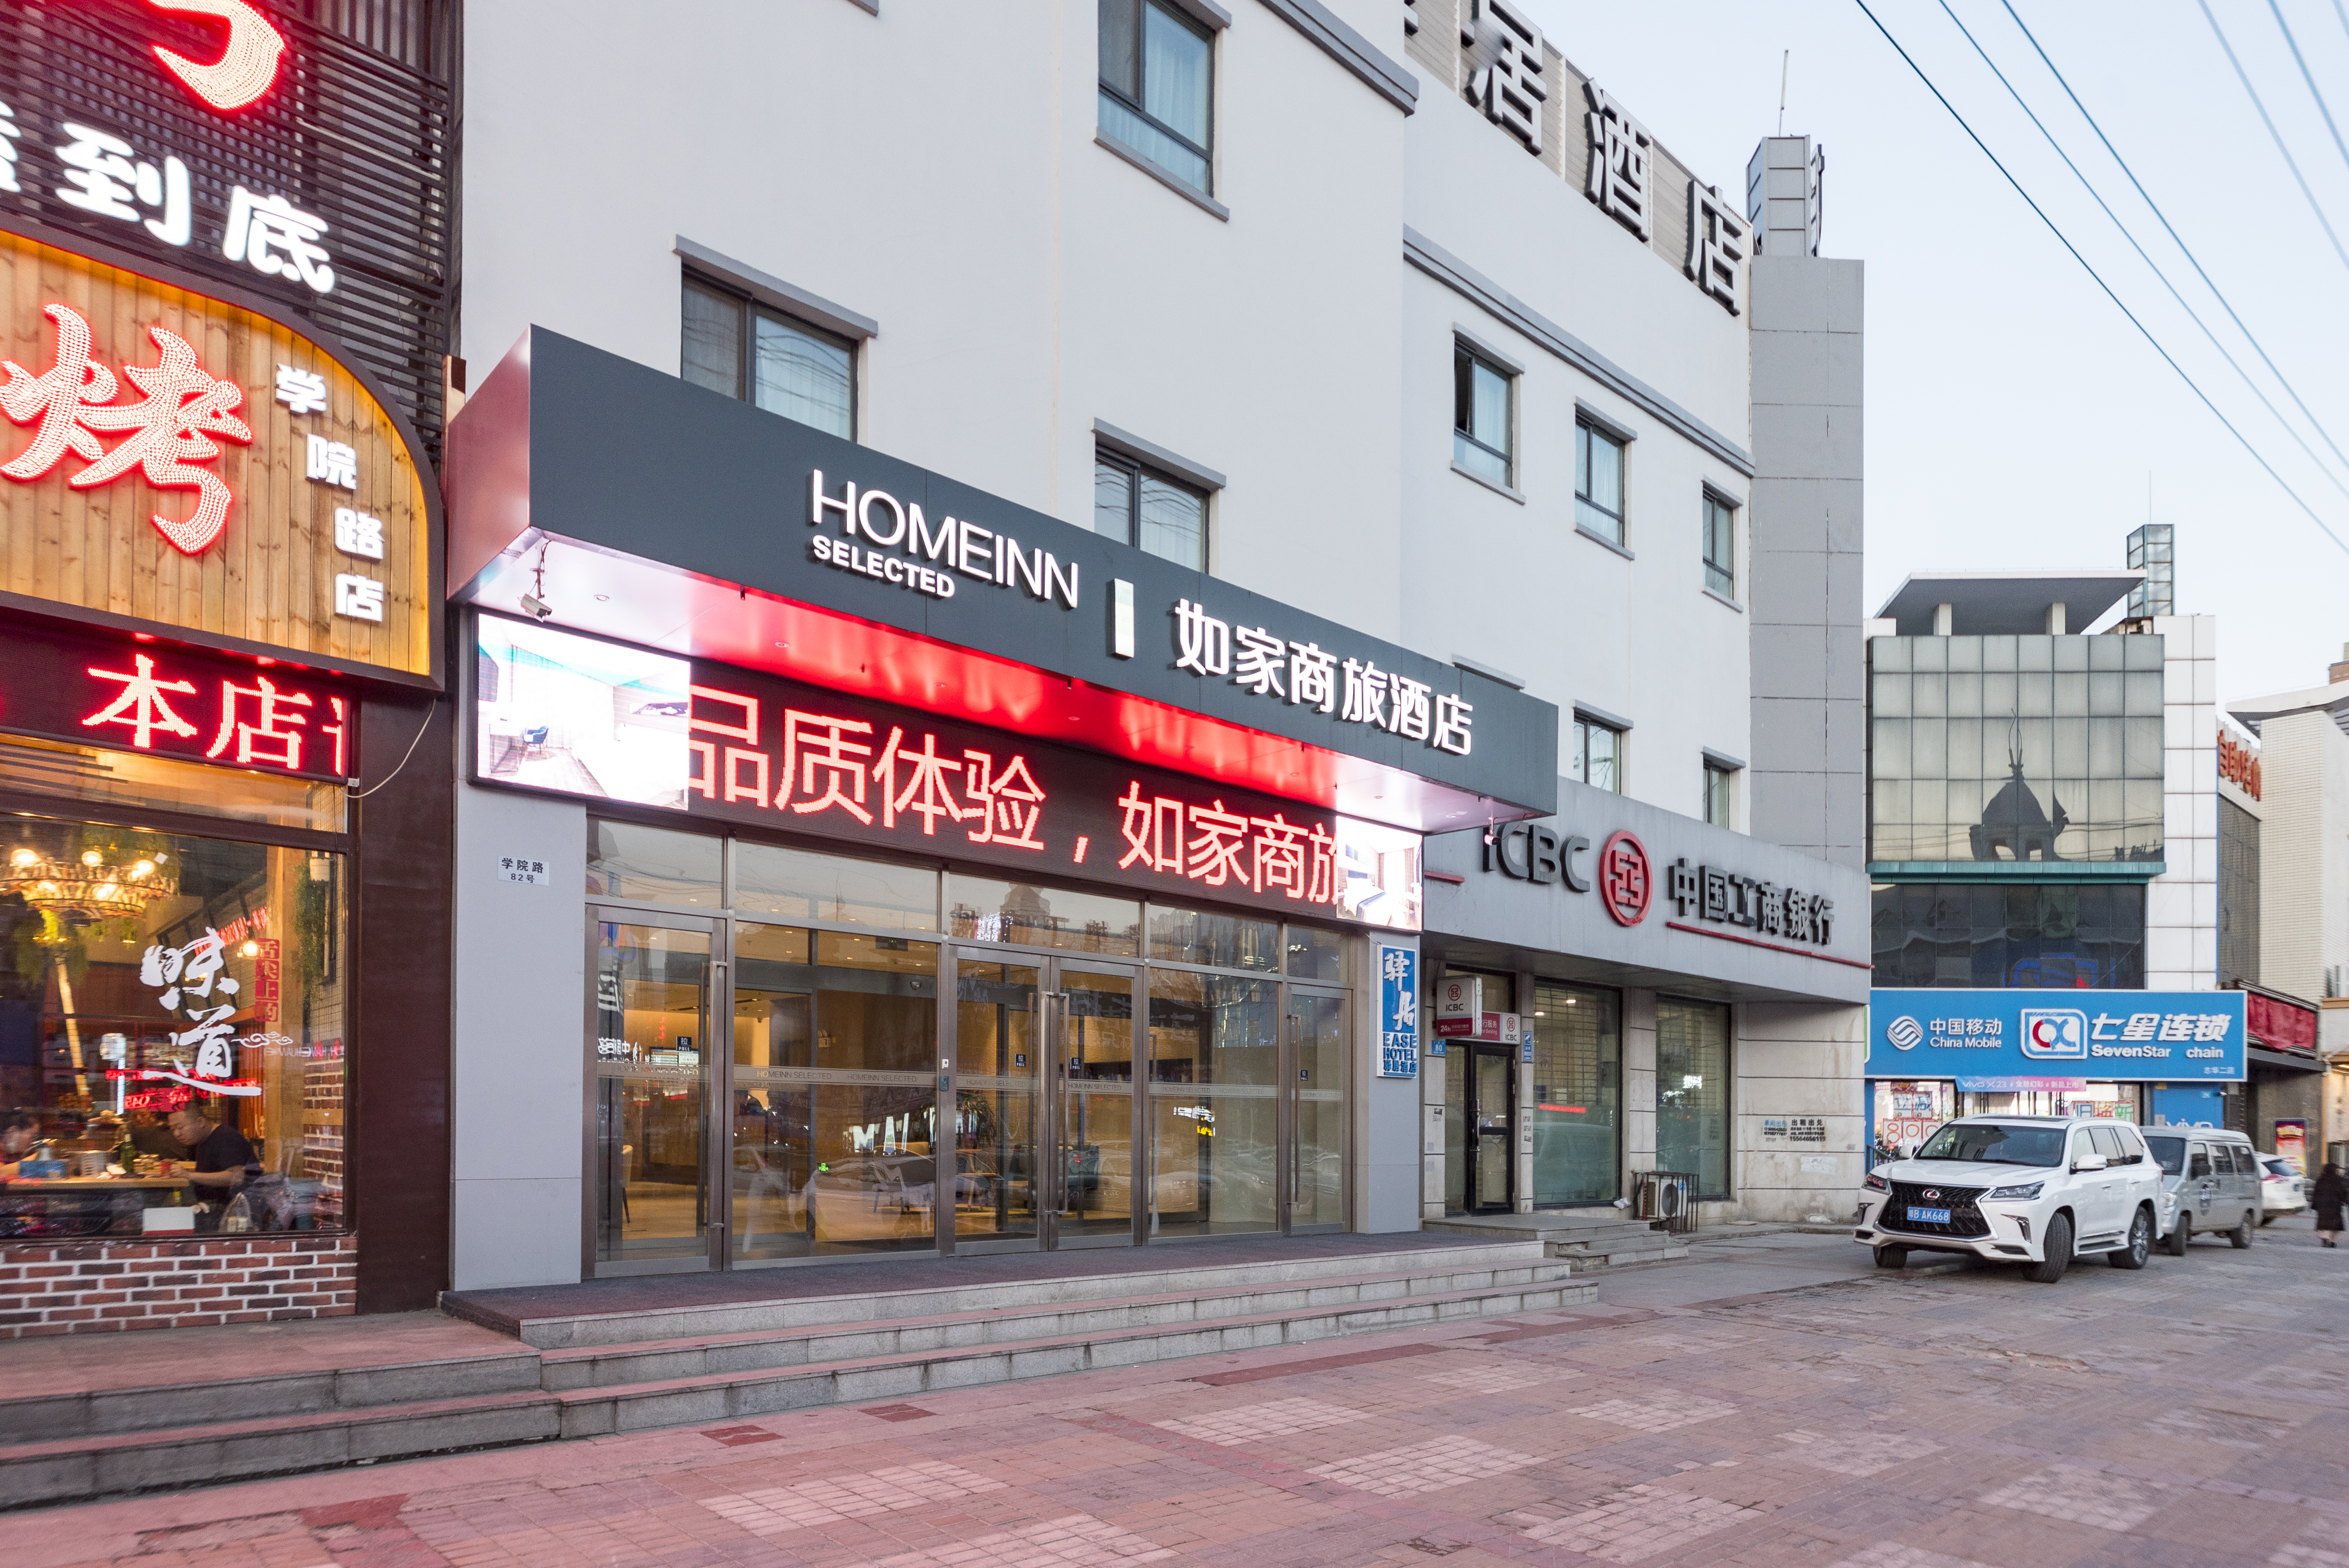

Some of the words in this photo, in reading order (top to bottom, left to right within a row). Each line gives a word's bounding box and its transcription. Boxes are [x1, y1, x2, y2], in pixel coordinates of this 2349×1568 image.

[1404, 0, 1742, 317] 居酒店
[0, 101, 335, 293] 到底
[0, 301, 253, 555] 烤
[275, 363, 385, 622] 学院路店
[813, 468, 1078, 608] HOMEINN
[812, 534, 956, 598] SELECTED
[1175, 597, 1473, 756] 如家商旅酒店
[501, 857, 543, 874] 学院路
[1482, 821, 1590, 893] ICBC
[511, 873, 534, 883] 82号
[1668, 858, 1835, 945] 中国工商银行
[140, 927, 262, 1096] 味道
[1445, 1003, 1464, 1012] ICBC
[1482, 1019, 1497, 1028] 行服务
[1929, 1018, 2002, 1036] 中国移动
[2091, 1012, 2232, 1043] 七星连锁
[680, 1037, 688, 1045] 拉
[1383, 1033, 1417, 1049] EASE
[1929, 1036, 1963, 1048] China
[1964, 1037, 2002, 1049] Mobile
[1383, 1047, 1417, 1061] HOTEL
[2091, 1044, 2172, 1059] SevenStar
[2186, 1045, 2224, 1059] chain
[612, 1064, 653, 1074] HOMENN
[1384, 1059, 1417, 1074] 驿居酒店
[793, 1071, 832, 1080] SELECTED
[881, 1074, 917, 1083] SELECTED
